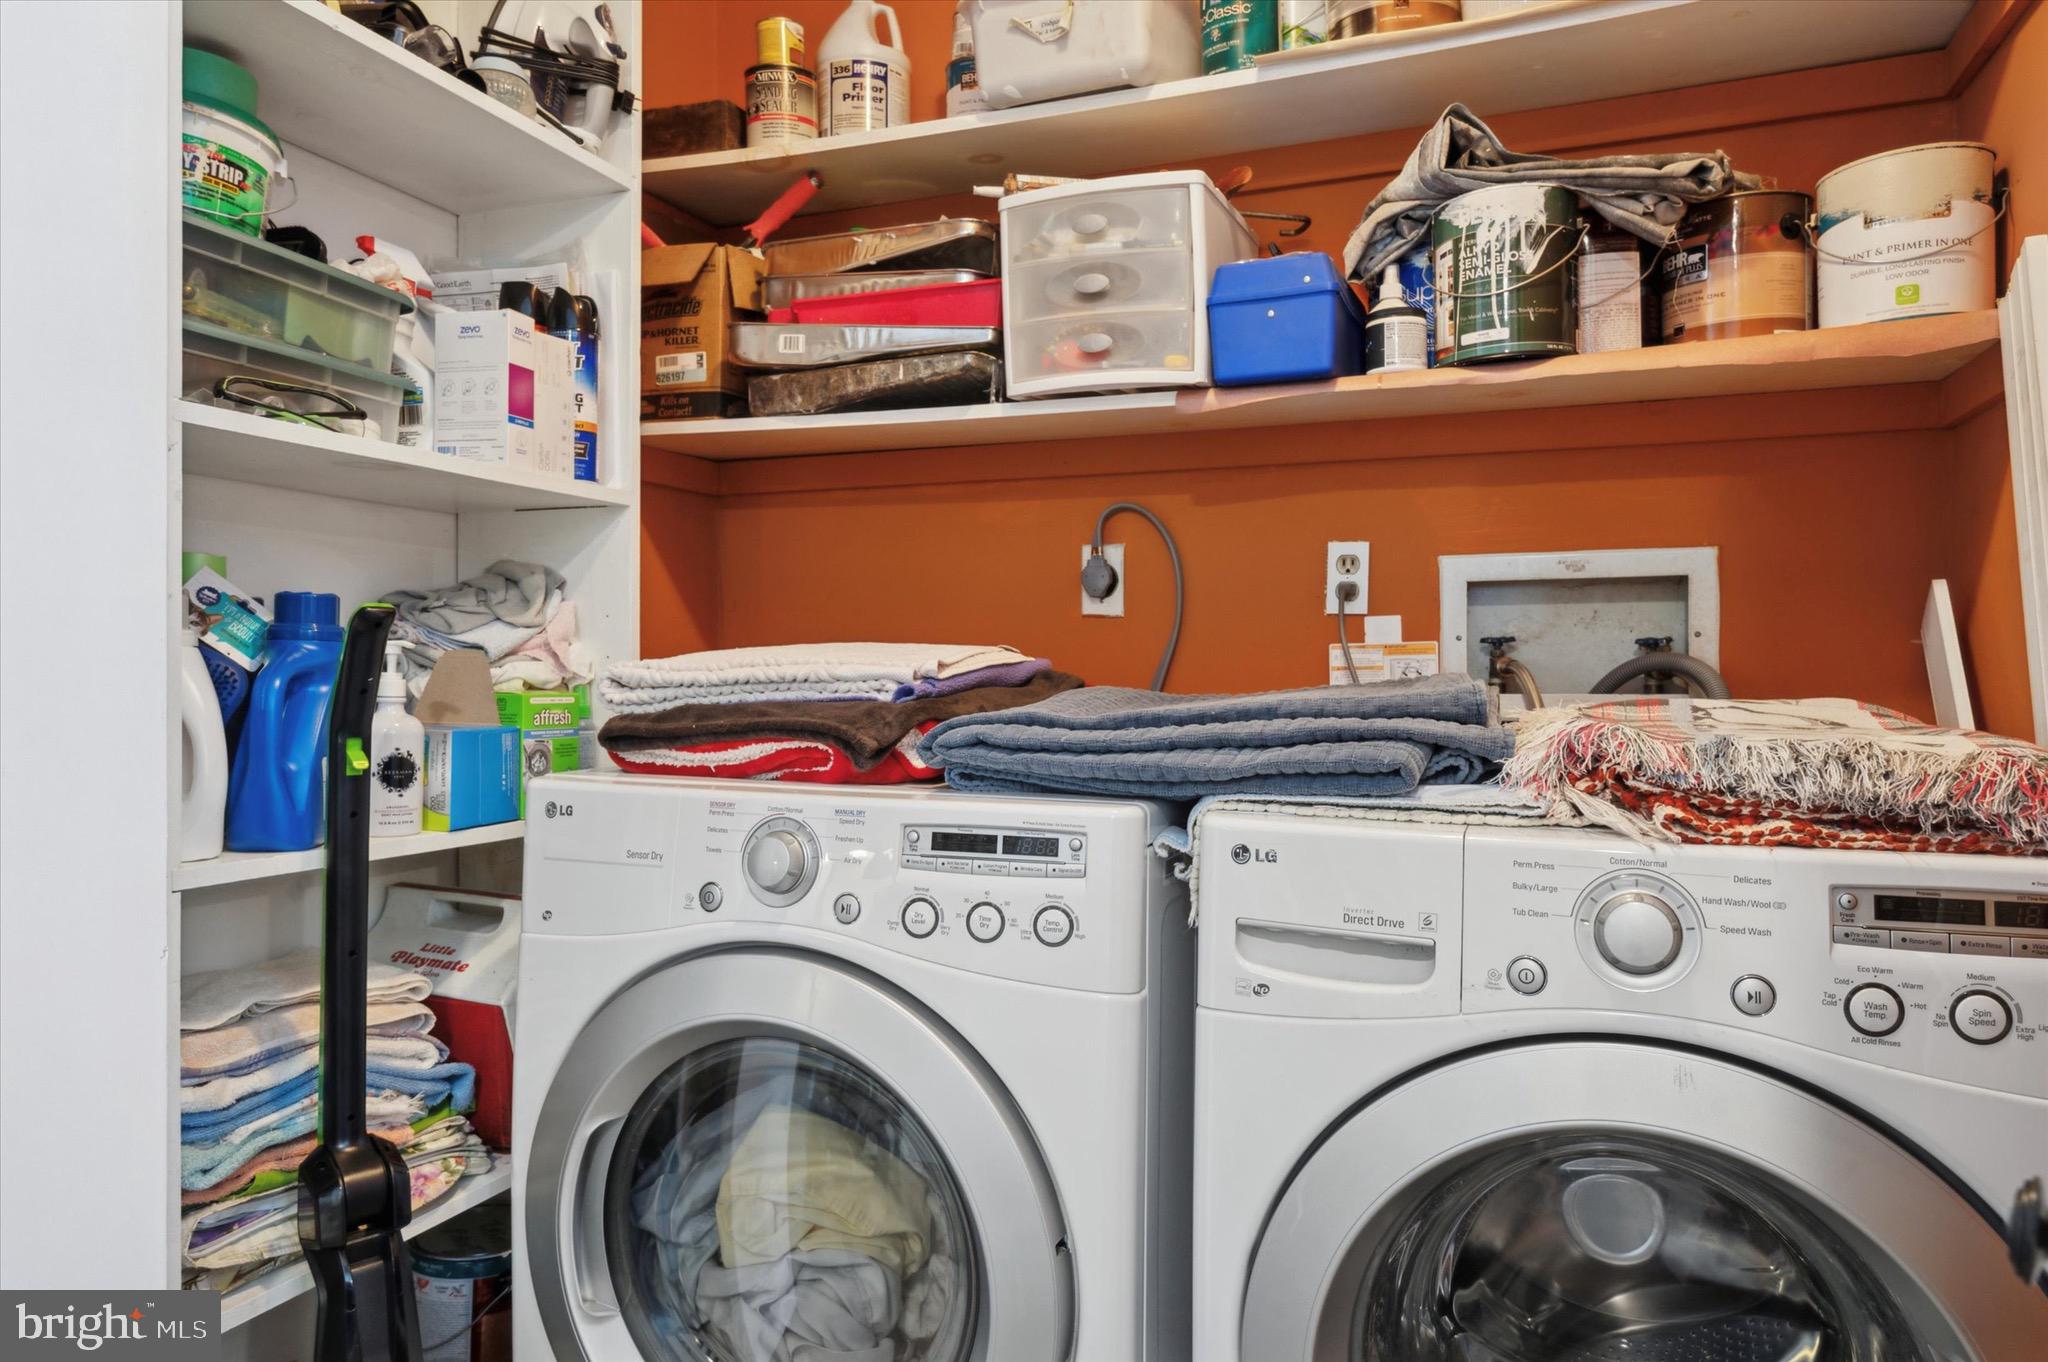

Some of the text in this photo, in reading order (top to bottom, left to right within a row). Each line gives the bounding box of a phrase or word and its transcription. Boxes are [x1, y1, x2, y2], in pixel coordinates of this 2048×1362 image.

[833, 65, 850, 75] 336
[961, 73, 977, 83] BEH
[852, 82, 884, 92] Flor
[842, 92, 884, 104] Prier
[203, 158, 244, 186] STRIP
[1875, 247, 1884, 256] &
[1887, 239, 1932, 254] PRIMER
[1936, 238, 1949, 247] IN
[1951, 237, 1974, 247] ONE
[1943, 257, 1966, 265] FINISH
[1885, 269, 1930, 281] LOW ODOR
[642, 296, 702, 319] ctracide
[460, 325, 481, 334] zevo
[664, 336, 699, 346] KILLER
[656, 371, 685, 384] 626197
[534, 709, 571, 727] affresh
[559, 804, 574, 817] LG
[767, 805, 803, 814] Cotton/Normal
[707, 826, 729, 834] Delicates
[626, 849, 664, 862] Sensor Dry
[1254, 848, 1278, 863] LG
[1609, 856, 1668, 868] Cotton/Normal
[1733, 875, 1772, 886] Delicates
[1512, 882, 1558, 893] Bulky/Large
[1702, 896, 1772, 909] Hand Wash/Wool
[914, 912, 924, 920] Dry
[1513, 907, 1549, 918] Tub Clean
[912, 917, 926, 925] Level
[1343, 913, 1405, 929] Direct Drive
[1720, 925, 1772, 936] Speed Wash
[419, 943, 456, 956] Little
[391, 950, 470, 973] Playmate
[1857, 965, 1893, 975] Eco Warm
[1966, 973, 1996, 981] Medium
[1901, 982, 1924, 990] Warm
[1864, 1001, 1888, 1010] Wash
[1972, 1008, 1992, 1018] Spin
[1932, 1020, 1949, 1028] Spin
[1968, 1017, 1996, 1027] Speed
[2016, 1025, 2035, 1033] Extra
[1861, 1037, 1877, 1045] Cold
[1878, 1038, 1901, 1047] Rinses
[2017, 1034, 2034, 1042] High
